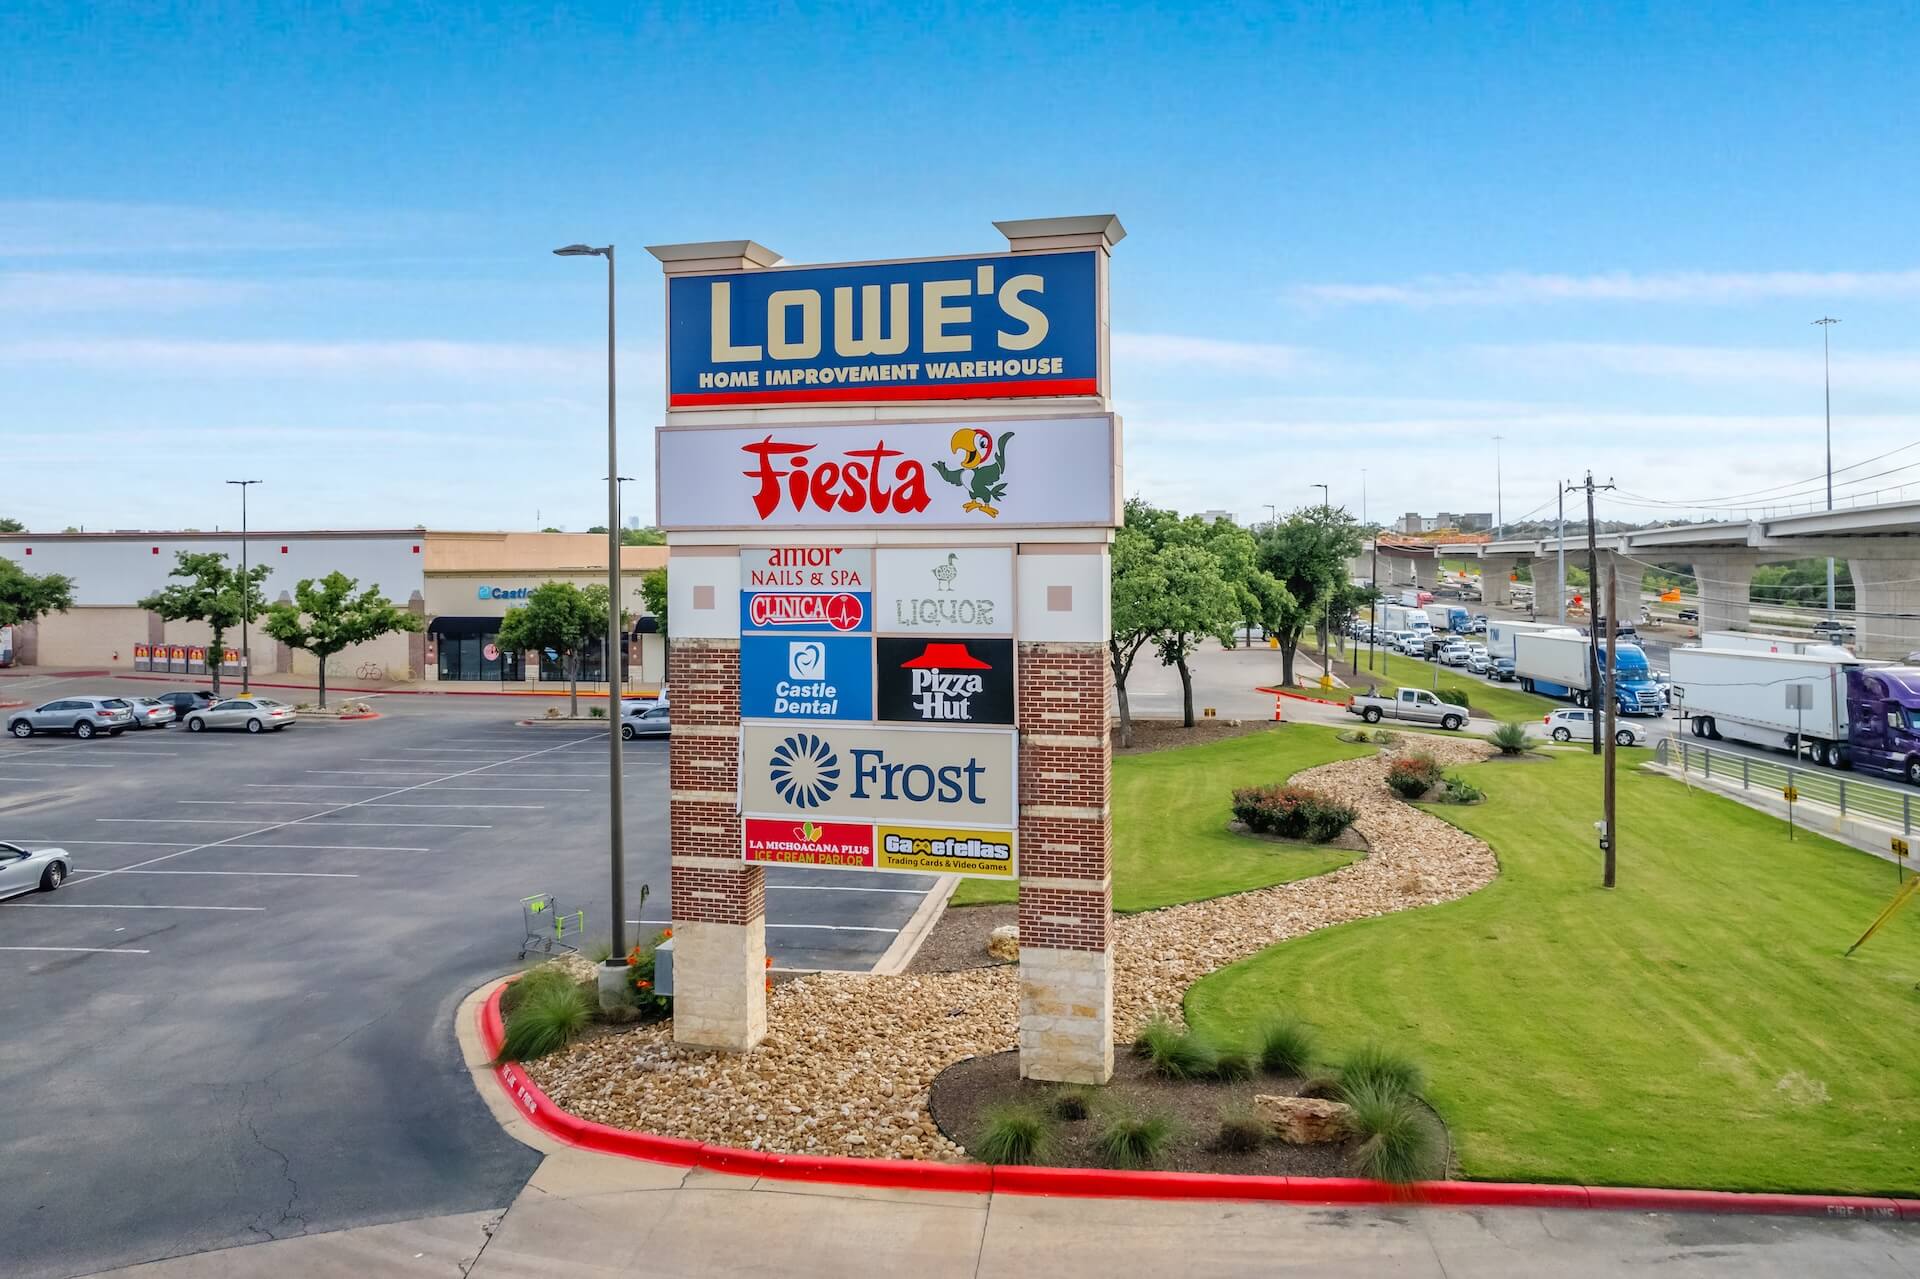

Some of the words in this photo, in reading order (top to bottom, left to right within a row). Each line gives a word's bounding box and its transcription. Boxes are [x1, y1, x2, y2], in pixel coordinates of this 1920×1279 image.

[711, 265, 1049, 363] LOWE'S
[700, 371, 759, 388] HOME
[766, 364, 919, 386] IMPROVEMENT
[926, 357, 1063, 379] WAREHOUSE
[741, 434, 931, 520] Fiesta
[768, 548, 832, 567] amor
[751, 570, 804, 586] NAILS
[810, 572, 824, 586] &
[831, 570, 862, 586] SPA
[752, 596, 825, 624] CLINICA
[896, 599, 994, 626] LIQUOR
[776, 681, 837, 698] Castle
[911, 668, 983, 697] Pizza
[774, 698, 838, 715] Dental
[912, 692, 970, 719] Hut
[850, 749, 986, 804] Frost
[749, 840, 764, 850] LA
[766, 841, 839, 853] MICHOACANA
[841, 845, 870, 855] PLUS
[754, 850, 773, 861] ICE
[776, 851, 815, 864] CREAM
[818, 854, 864, 866] PARLOR
[884, 834, 1010, 860] Gamefellas
[887, 857, 918, 867] Trading
[920, 858, 944, 868] Cards
[945, 859, 952, 868] &
[953, 860, 977, 870] Video
[978, 862, 1008, 872] Games
